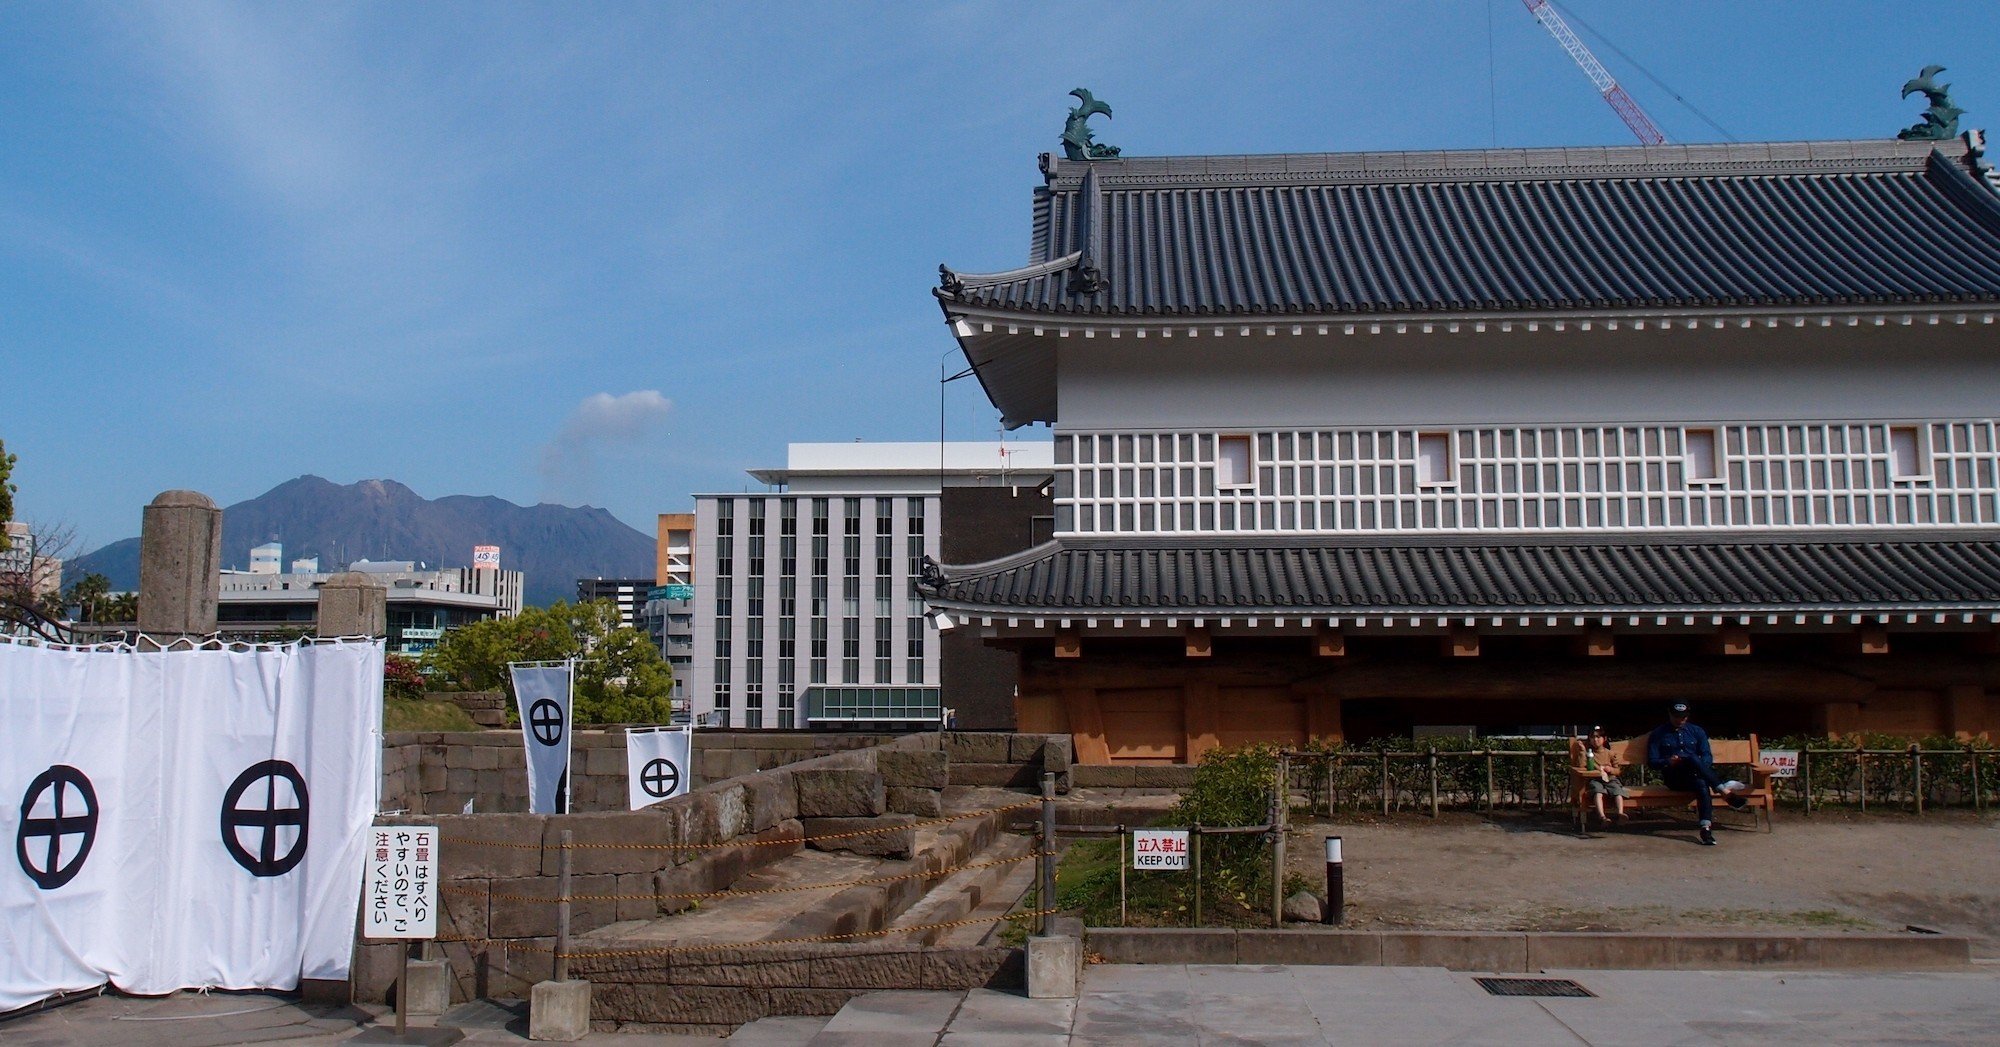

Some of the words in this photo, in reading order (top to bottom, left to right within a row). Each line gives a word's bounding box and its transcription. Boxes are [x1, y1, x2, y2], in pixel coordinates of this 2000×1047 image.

[374, 832, 389, 924] 注意ください
[394, 832, 411, 932] やすいので、ご
[414, 832, 430, 922] 石畳はすべり
[1137, 838, 1186, 852] 立入禁止
[1137, 855, 1163, 865] KEEP
[1165, 855, 1186, 865] OUT
